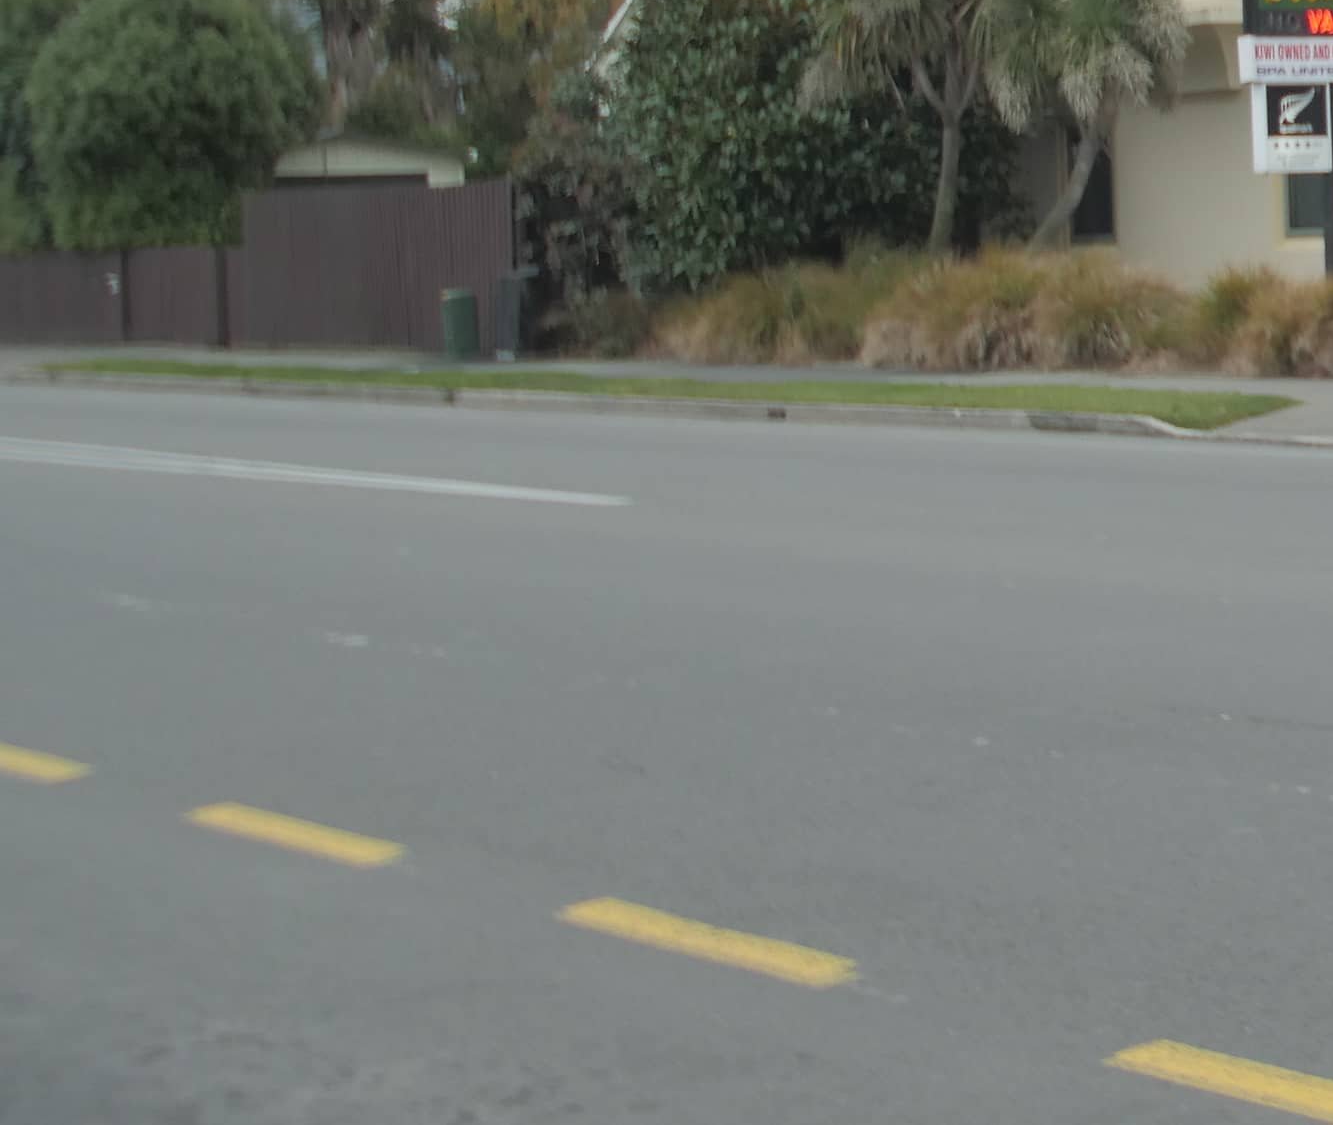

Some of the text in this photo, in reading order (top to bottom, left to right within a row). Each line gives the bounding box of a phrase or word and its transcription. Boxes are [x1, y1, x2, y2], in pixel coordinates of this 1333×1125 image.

[1255, 44, 1275, 60] KIWI
[1278, 44, 1311, 60] OWNED
[1313, 44, 1330, 60] AND
